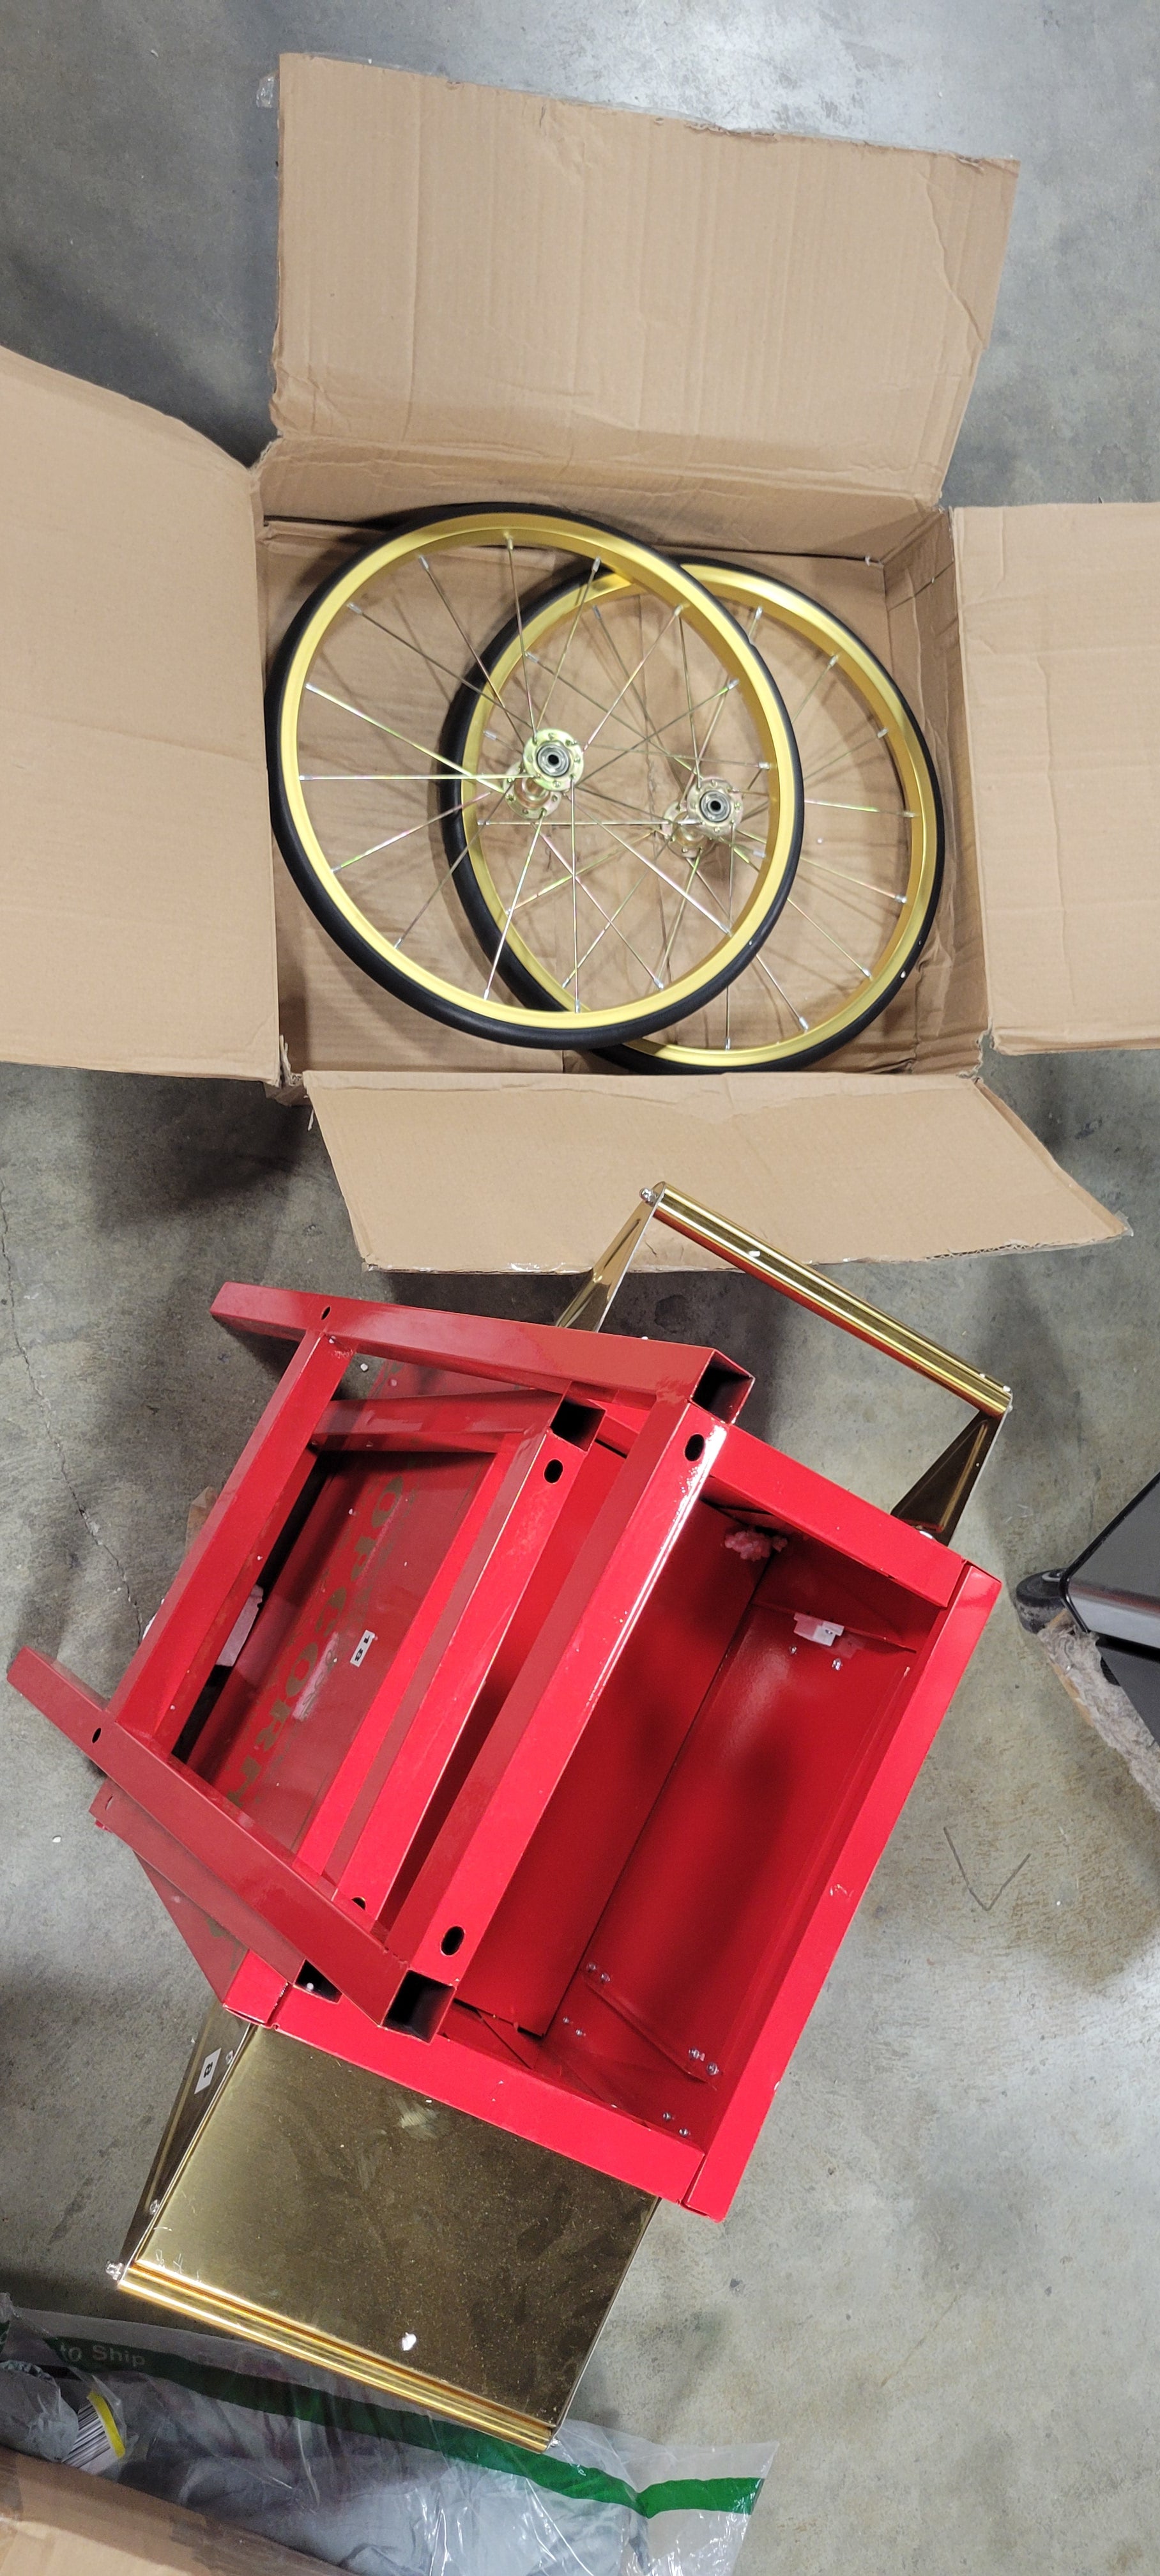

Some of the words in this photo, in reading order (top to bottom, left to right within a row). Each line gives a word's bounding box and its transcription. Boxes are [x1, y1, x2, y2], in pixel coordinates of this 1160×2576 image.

[227, 1473, 405, 1807] OPCORN
[60, 2342, 82, 2362] to
[92, 2345, 146, 2367] Ship
